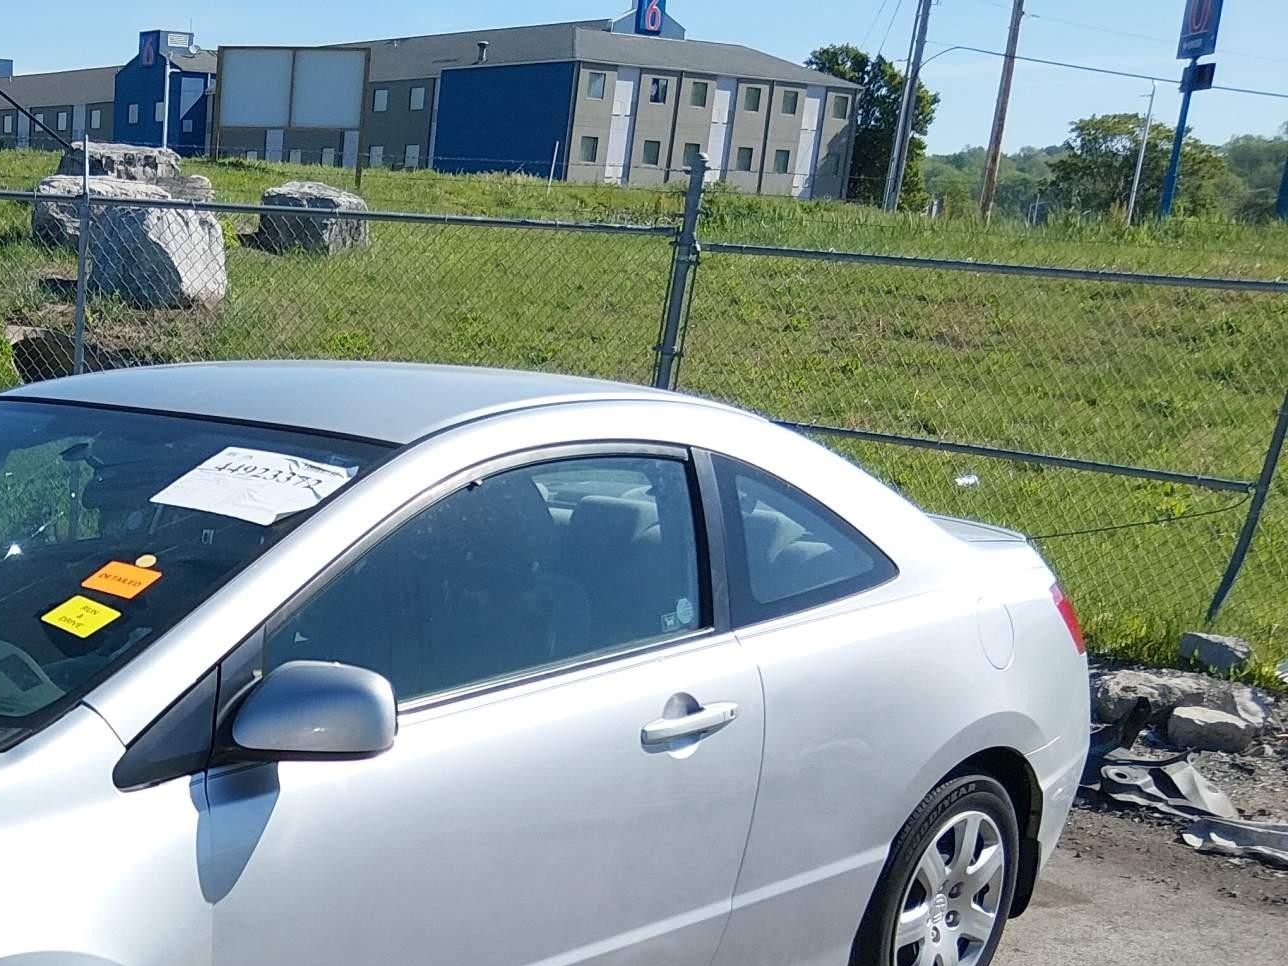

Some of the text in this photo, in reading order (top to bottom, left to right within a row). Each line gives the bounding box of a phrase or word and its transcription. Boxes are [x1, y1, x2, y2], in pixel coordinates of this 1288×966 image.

[645, 0, 661, 31] 6
[143, 36, 154, 65] 6
[98, 572, 142, 587] DETAILED
[80, 605, 101, 616] RUN
[58, 616, 85, 629] DRIVE
[904, 783, 976, 864] GOODYEAR
